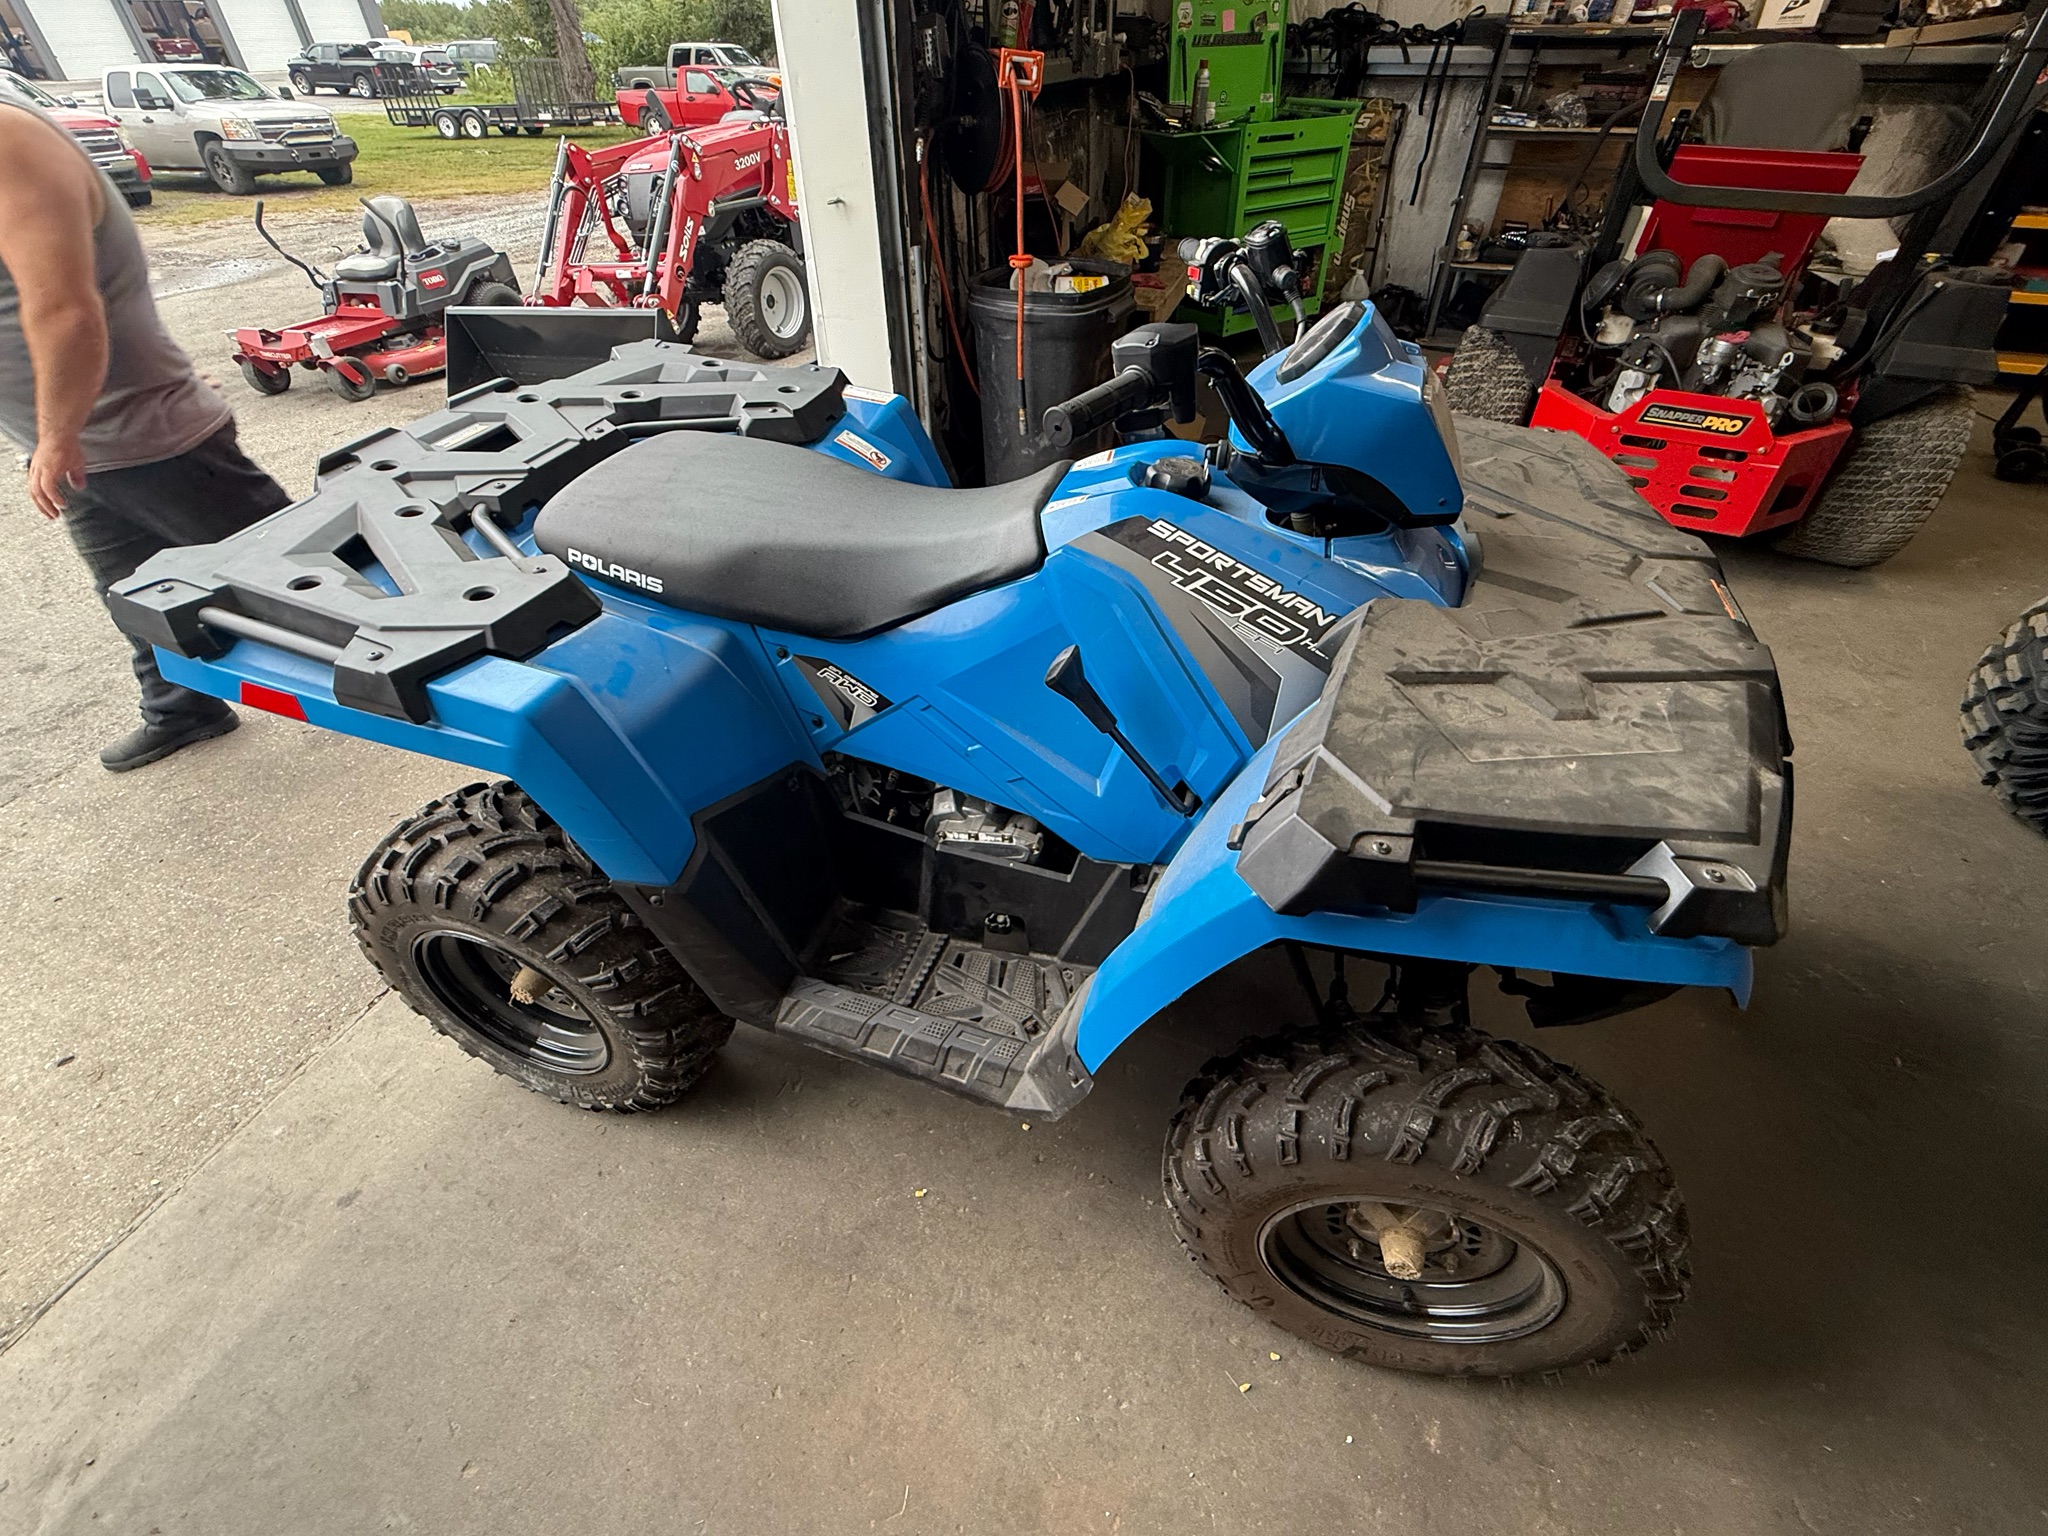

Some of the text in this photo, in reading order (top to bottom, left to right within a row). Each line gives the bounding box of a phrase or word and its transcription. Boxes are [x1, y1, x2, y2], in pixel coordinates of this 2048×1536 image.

[734, 151, 761, 171] 3200V
[567, 547, 664, 594] POLARIS
[1146, 519, 1336, 627] SPORTSMAN
[1151, 551, 1309, 645] 450
[816, 667, 878, 707] AWD
